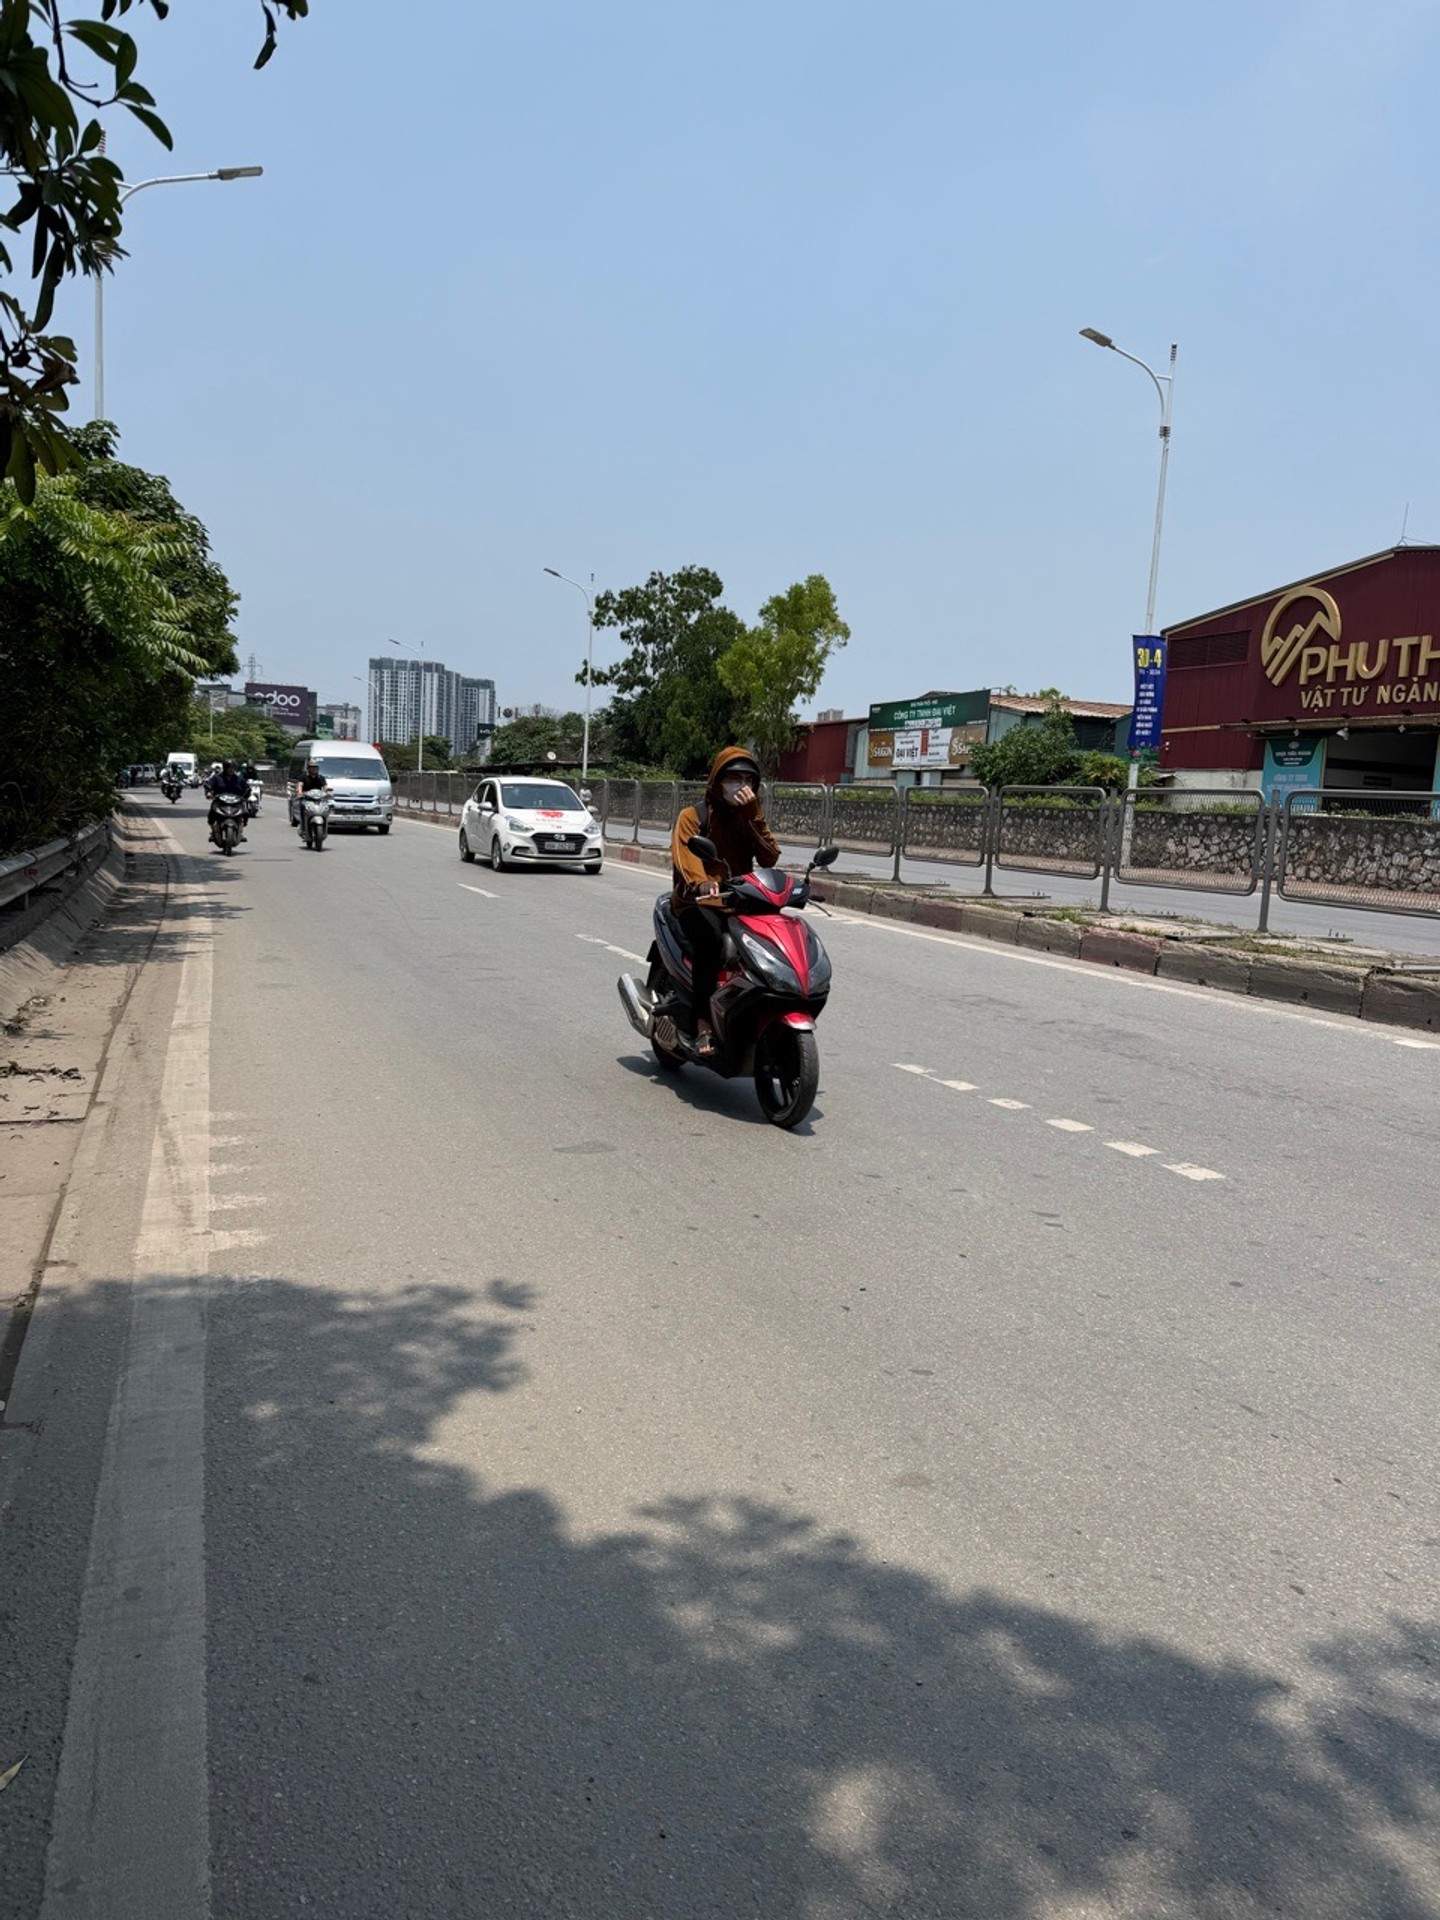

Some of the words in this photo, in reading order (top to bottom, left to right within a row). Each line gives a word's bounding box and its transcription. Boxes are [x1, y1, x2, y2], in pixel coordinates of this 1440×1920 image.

[1300, 685, 1336, 713] VẬT
[1340, 685, 1369, 706] TƯ
[1376, 676, 1440, 705] NGÀN
